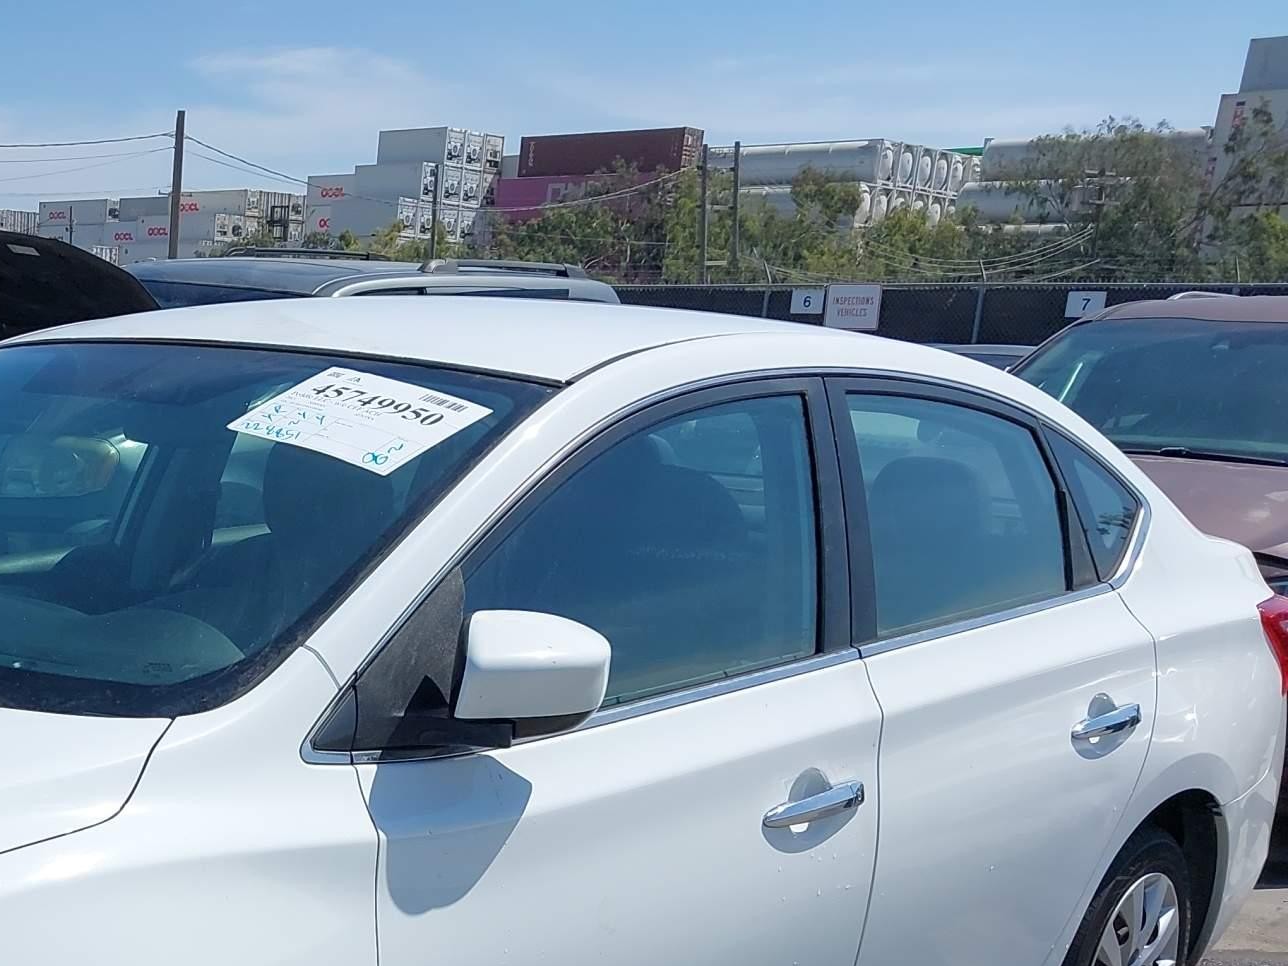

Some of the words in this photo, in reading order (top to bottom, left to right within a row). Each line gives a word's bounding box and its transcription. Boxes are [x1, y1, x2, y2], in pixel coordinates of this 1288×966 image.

[148, 227, 169, 236] OOCL
[114, 232, 134, 242] OOCL
[803, 295, 812, 308] 6
[832, 296, 874, 306] INSPECTIONS
[1082, 297, 1092, 311] 7
[836, 308, 869, 317] VEHICLES
[312, 383, 445, 427] 45749950
